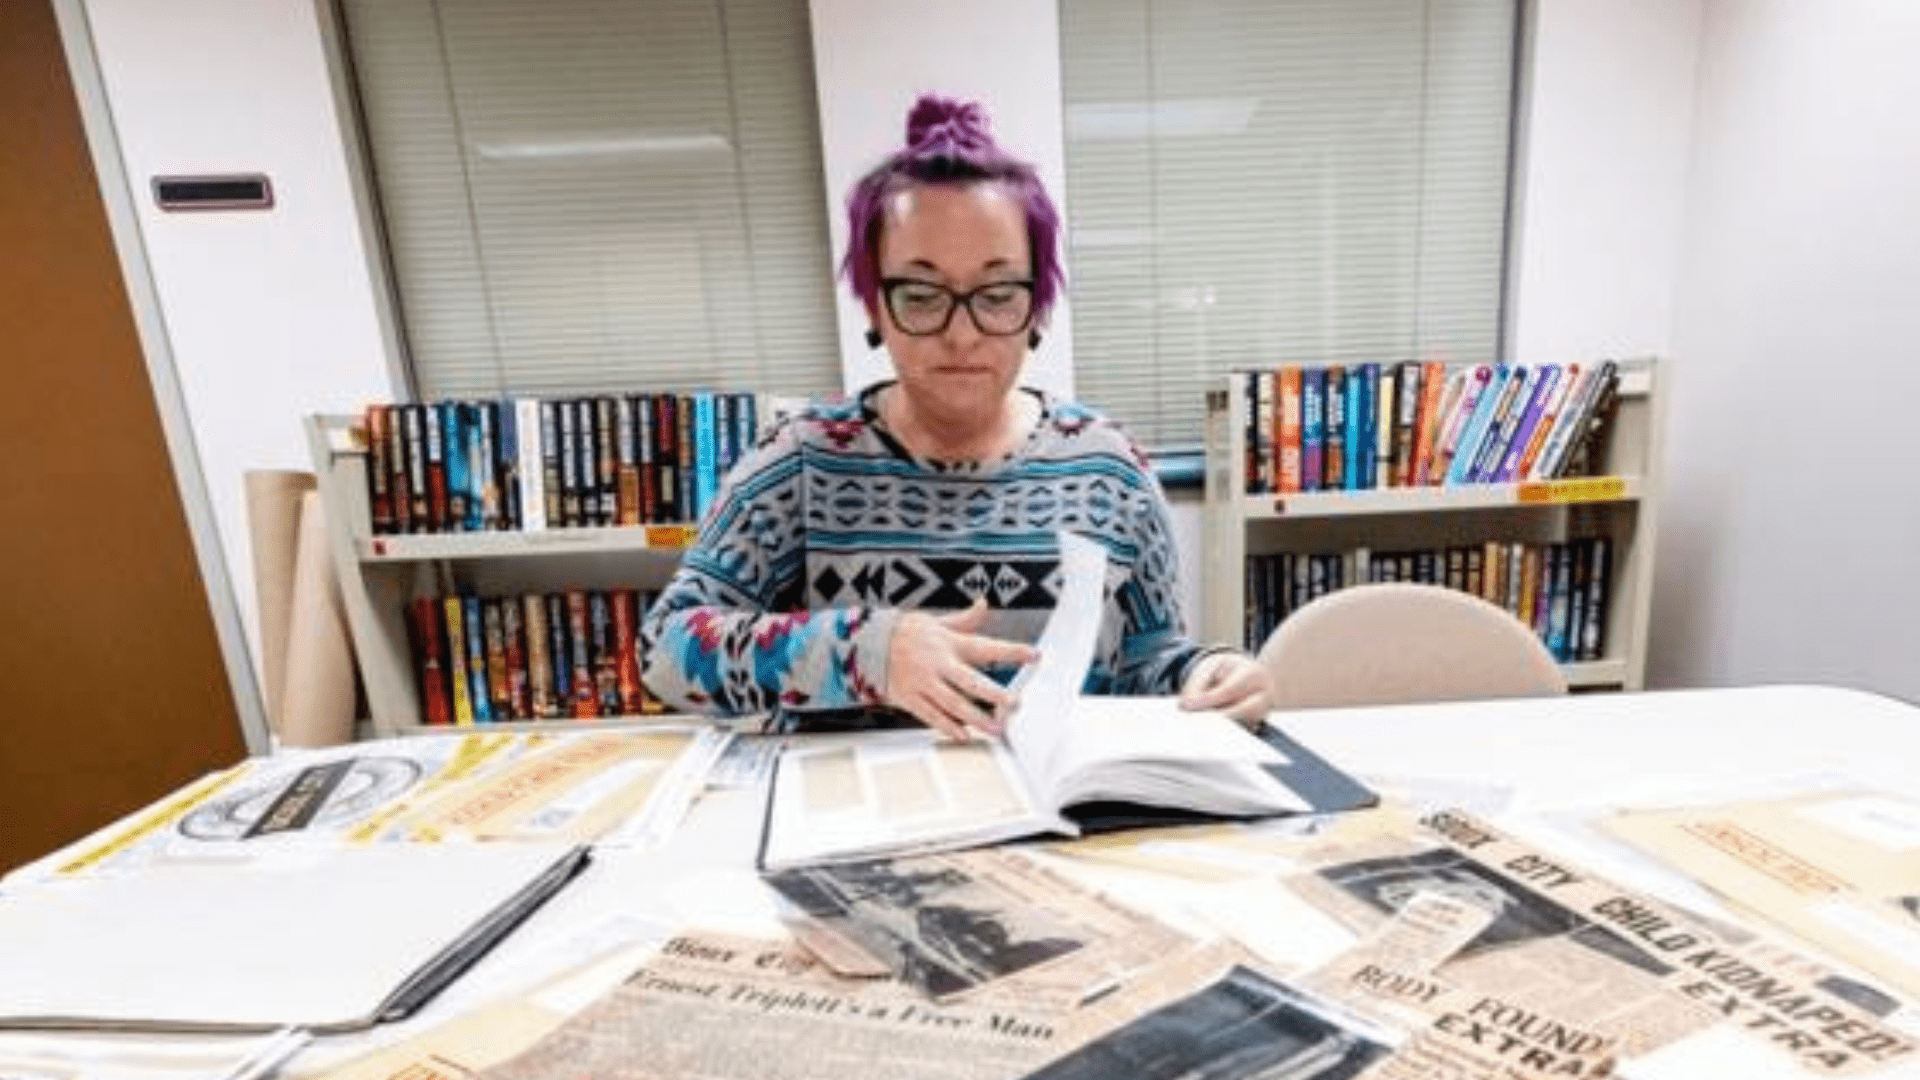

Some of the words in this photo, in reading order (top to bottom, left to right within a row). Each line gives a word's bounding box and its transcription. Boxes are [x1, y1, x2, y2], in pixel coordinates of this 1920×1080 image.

[1503, 854, 1580, 890] CITY
[1592, 897, 1698, 952] CHILD
[622, 967, 721, 997] Ernest
[989, 1014, 1053, 1041] Man
[1432, 1011, 1584, 1076] EXTRA
[1680, 980, 1850, 1068] EXTRA
